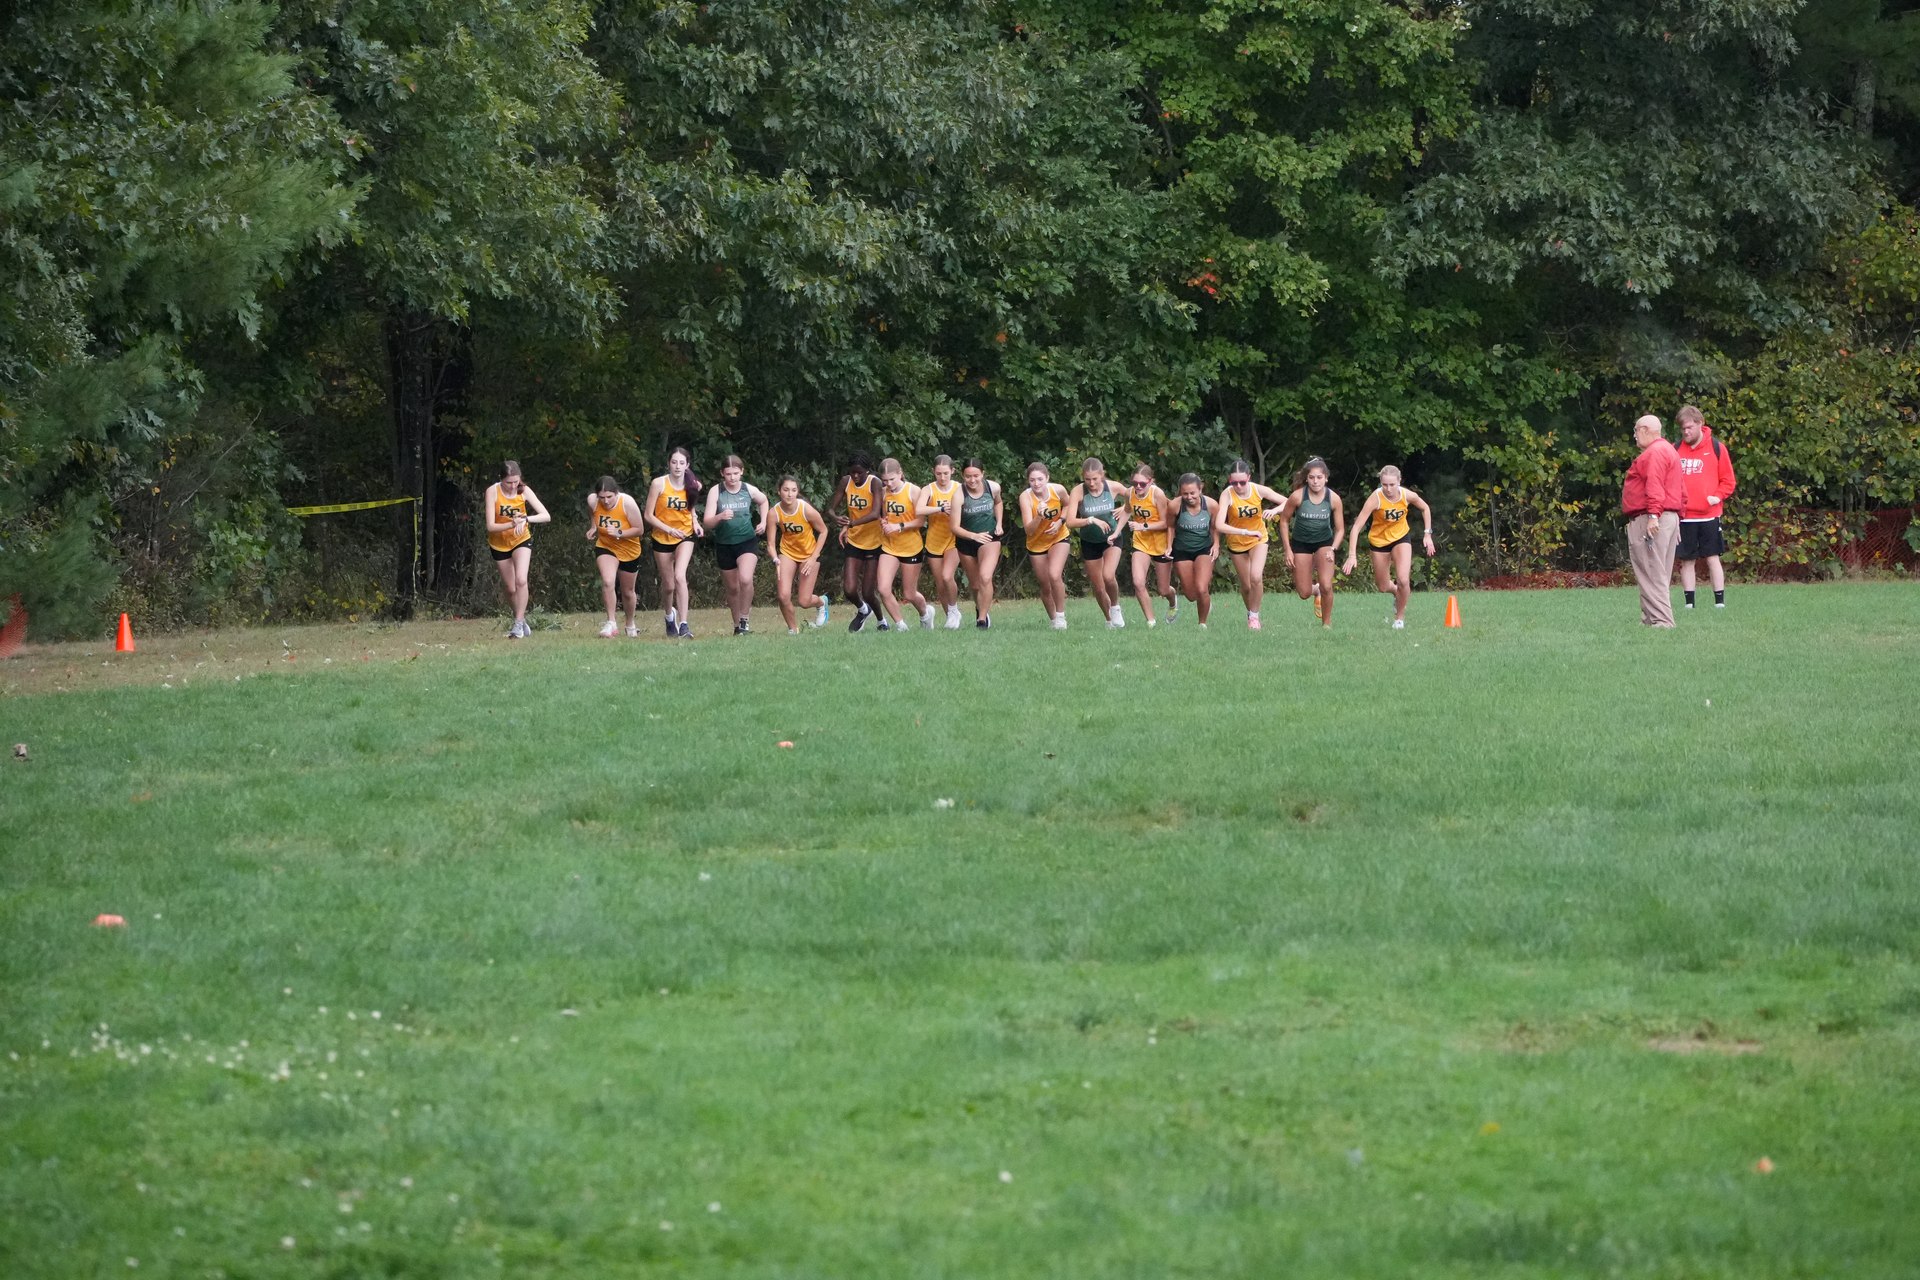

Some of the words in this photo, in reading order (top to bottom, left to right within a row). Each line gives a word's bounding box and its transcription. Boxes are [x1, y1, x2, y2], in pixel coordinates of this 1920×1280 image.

[666, 496, 688, 511] KP
[721, 501, 748, 511] MANSFIELD
[849, 494, 868, 511] KP
[886, 500, 905, 516] KP
[963, 502, 993, 513] MANSFIELD
[1084, 503, 1113, 513] MANSFIELD
[1132, 505, 1151, 520] KP
[1237, 505, 1259, 519] KP
[1300, 512, 1330, 520] MANSFIELD
[1384, 508, 1405, 522] KP
[782, 522, 804, 535] KP
